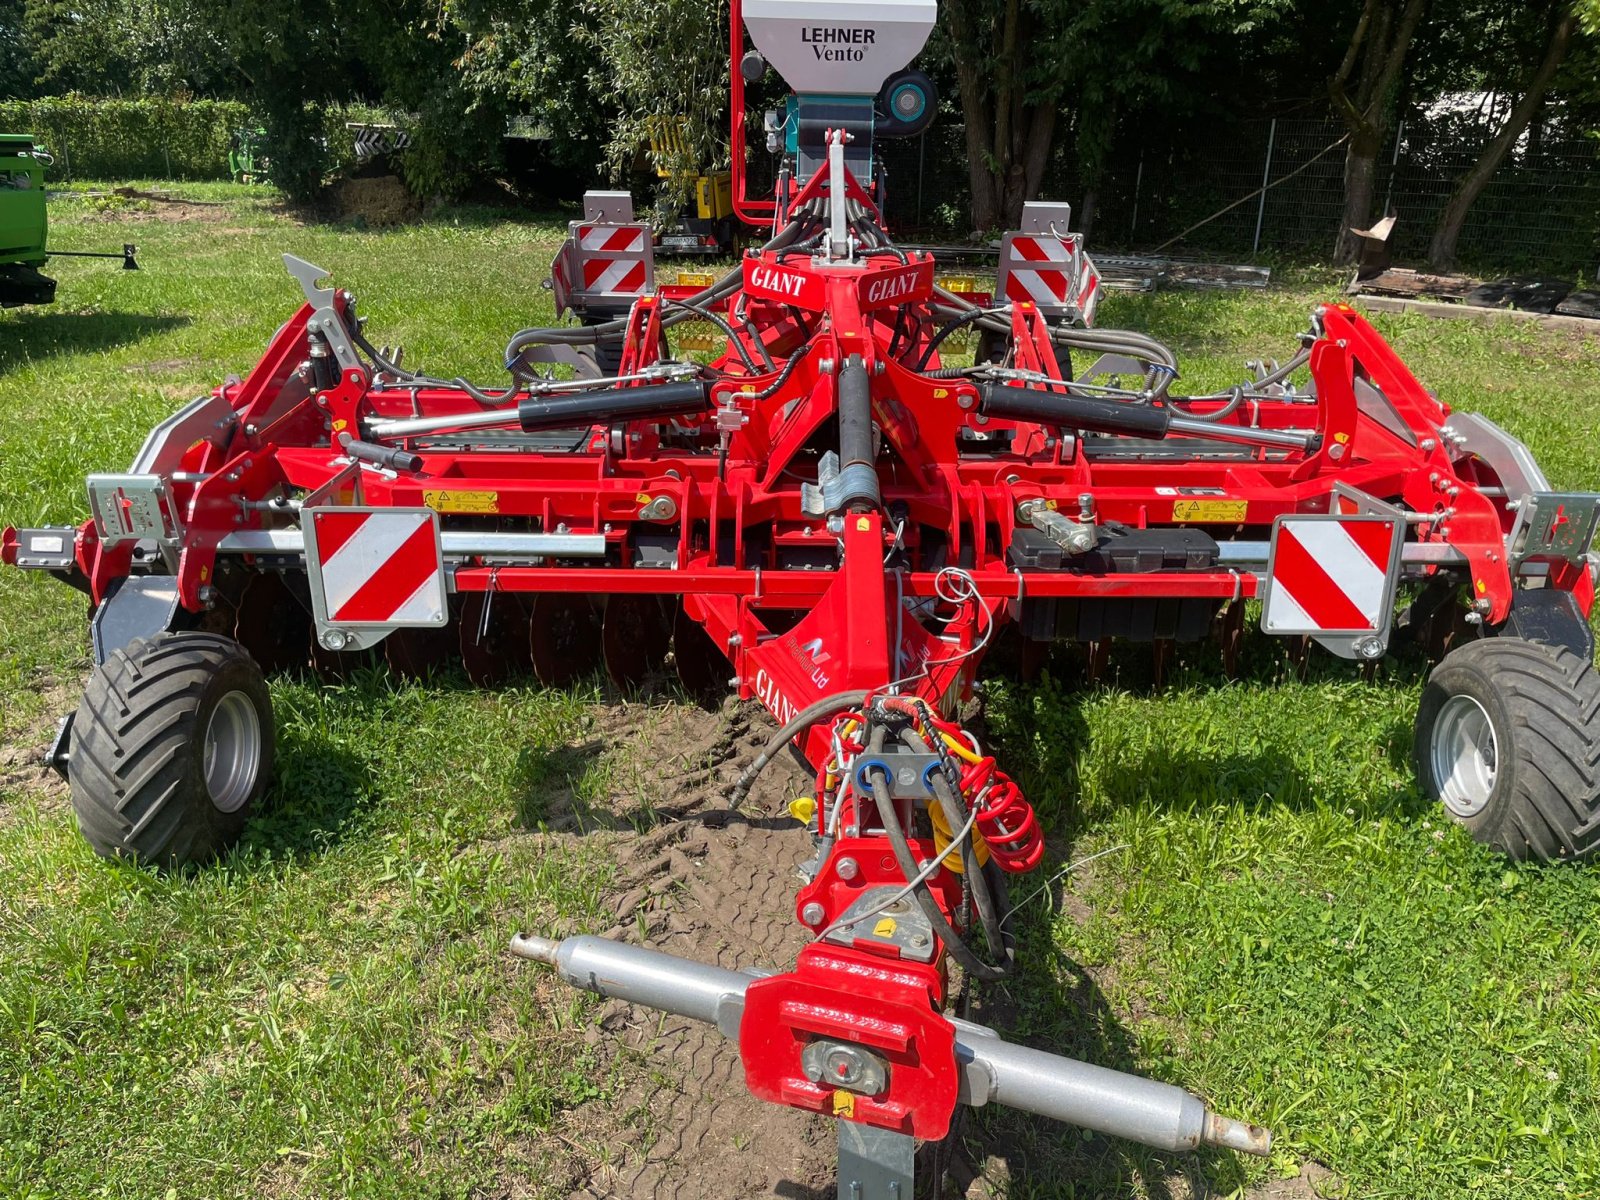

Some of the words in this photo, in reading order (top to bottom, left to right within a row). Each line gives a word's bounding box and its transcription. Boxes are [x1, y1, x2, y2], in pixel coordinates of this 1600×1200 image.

[802, 28, 875, 44] LEHNER
[751, 266, 806, 297] GIANT
[868, 271, 919, 303] GIANT
